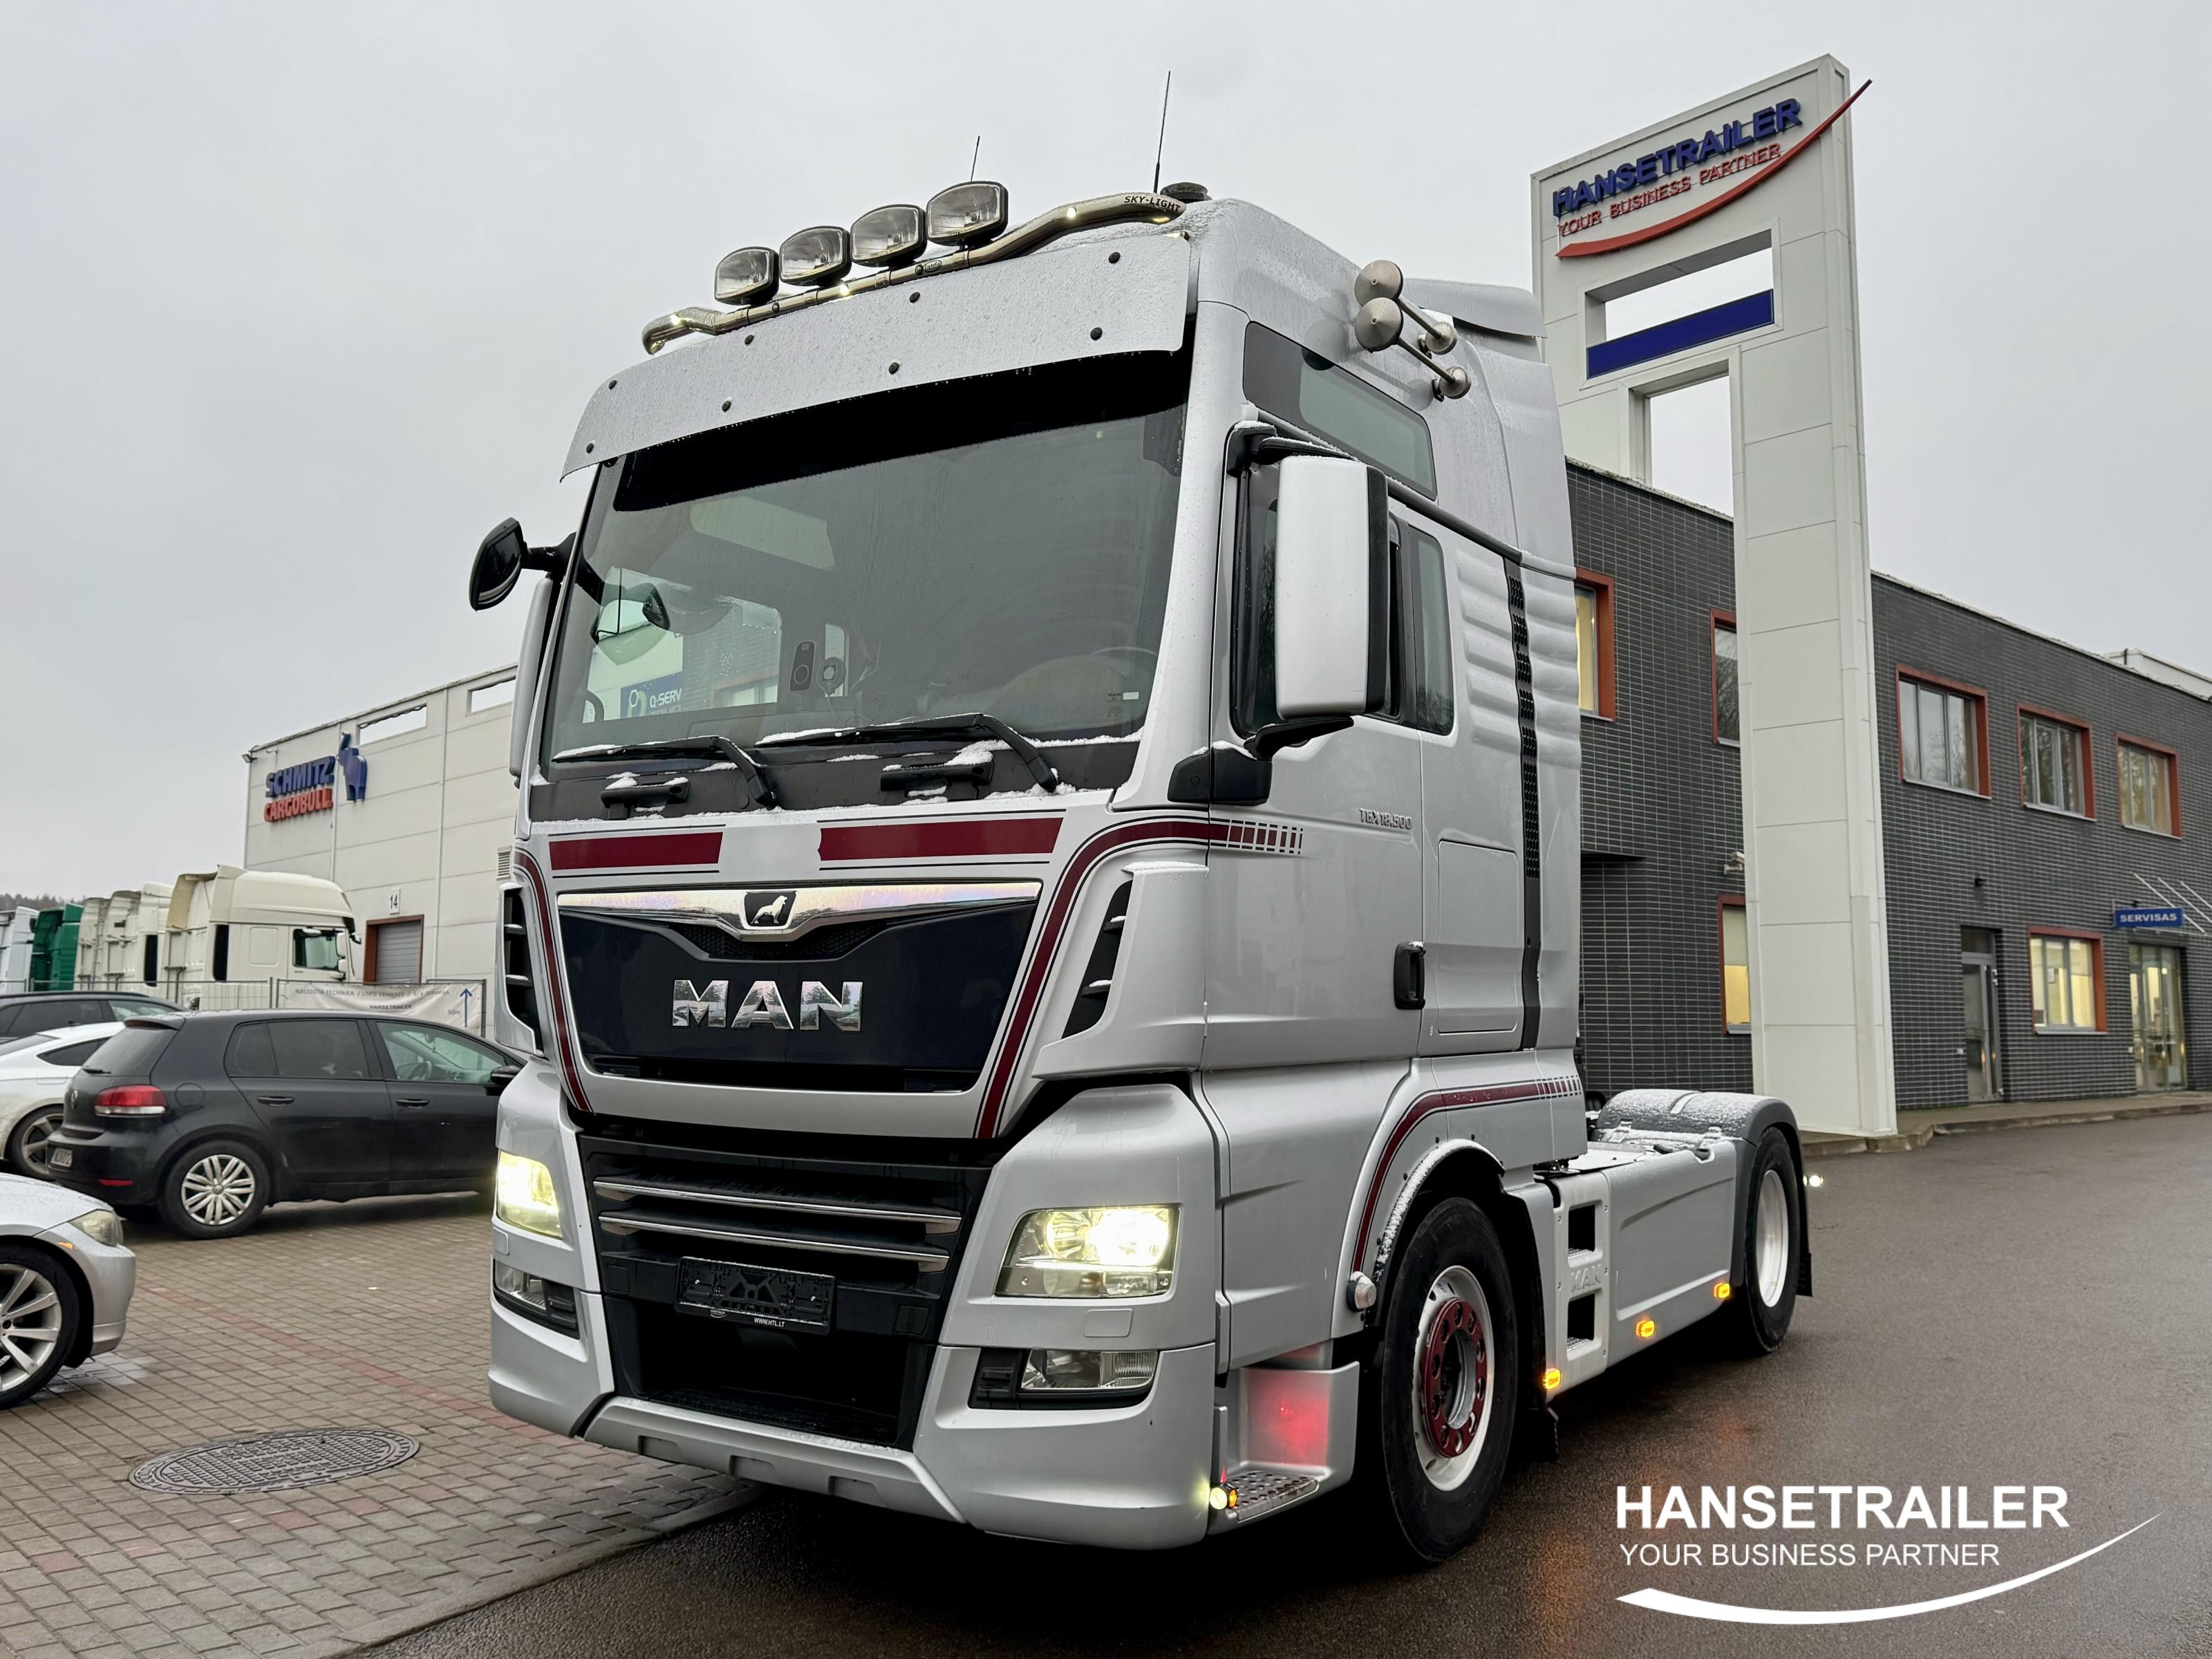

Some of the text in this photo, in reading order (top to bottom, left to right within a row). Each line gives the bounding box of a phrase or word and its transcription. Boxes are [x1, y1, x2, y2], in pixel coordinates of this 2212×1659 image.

[1553, 98, 1802, 217] HANSETRAILER
[1124, 196, 1181, 212] SKY-LIGHT
[1557, 143, 1781, 236] YOUR BUSINESS PARTNER
[265, 756, 335, 798] SCHMITZ
[390, 894, 397, 909] 14
[2119, 913, 2177, 922] SERVISAS
[672, 980, 863, 1032] MAN
